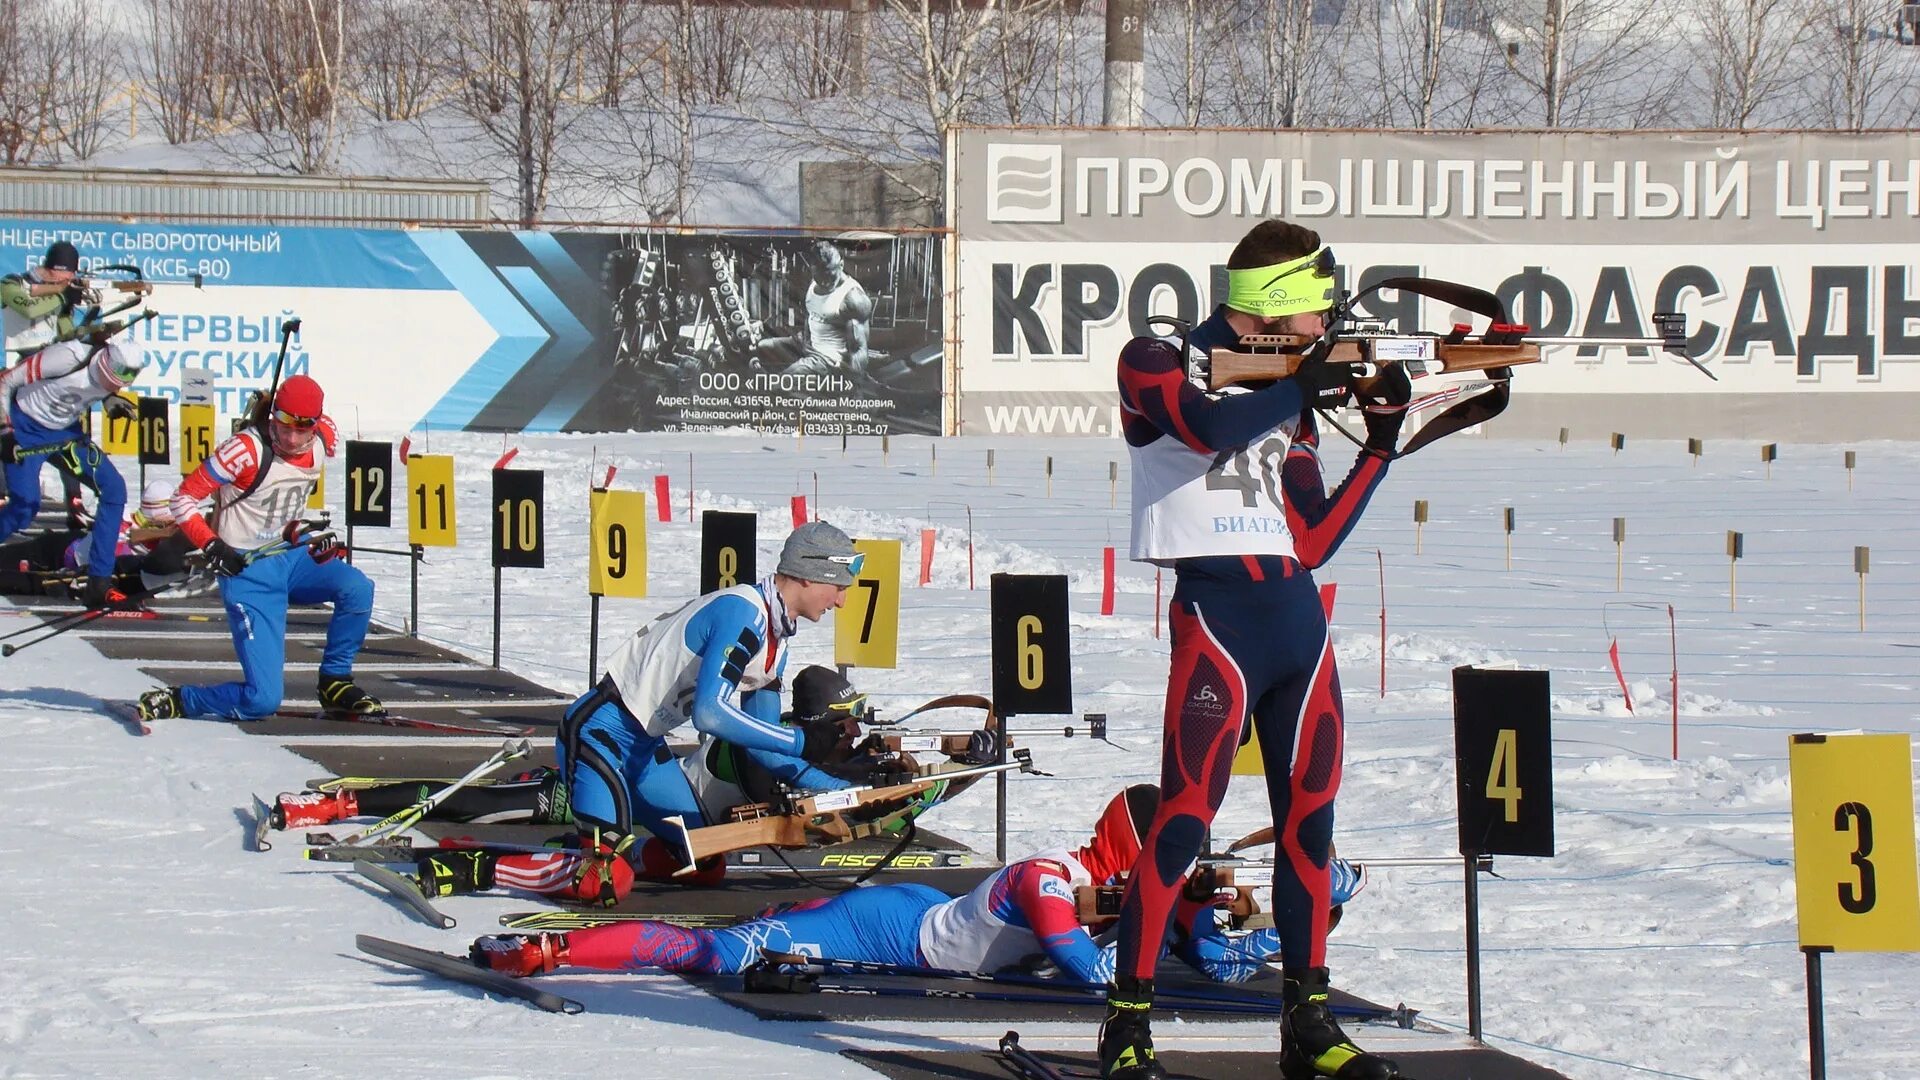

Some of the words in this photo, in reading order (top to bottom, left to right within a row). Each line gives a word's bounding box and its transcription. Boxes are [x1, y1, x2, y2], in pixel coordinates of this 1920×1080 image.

[1076, 147, 1749, 218] ПРОМЫШЛЕННЫЙ
[111, 231, 281, 253] СЫВОРОТОЧНЫЙ
[142, 257, 232, 280] (КСБ-80)
[127, 309, 302, 344] ПЕРВЫЙ
[992, 263, 1420, 356] КРОЯ
[655, 394, 691, 406] Адрес:
[692, 395, 732, 407] Россия,
[775, 396, 837, 409] Республика
[839, 398, 896, 409] Мордовия,
[700, 373, 740, 390] ООО
[744, 374, 854, 391] «ПРОТЕИН»
[140, 416, 166, 455] 16
[680, 408, 750, 420] Ичалковский
[799, 410, 872, 422] Рождествено,
[804, 423, 844, 436] (83433)
[845, 424, 889, 436] 3-03-07
[184, 425, 210, 464] 15
[350, 466, 384, 512] 12
[415, 483, 448, 531] 11
[498, 499, 538, 551] 10
[607, 523, 628, 580] 9
[717, 546, 738, 590] 8
[857, 579, 880, 644] 7
[1017, 614, 1044, 690] 6
[1485, 729, 1522, 823] 4
[1834, 801, 1877, 914] 3
